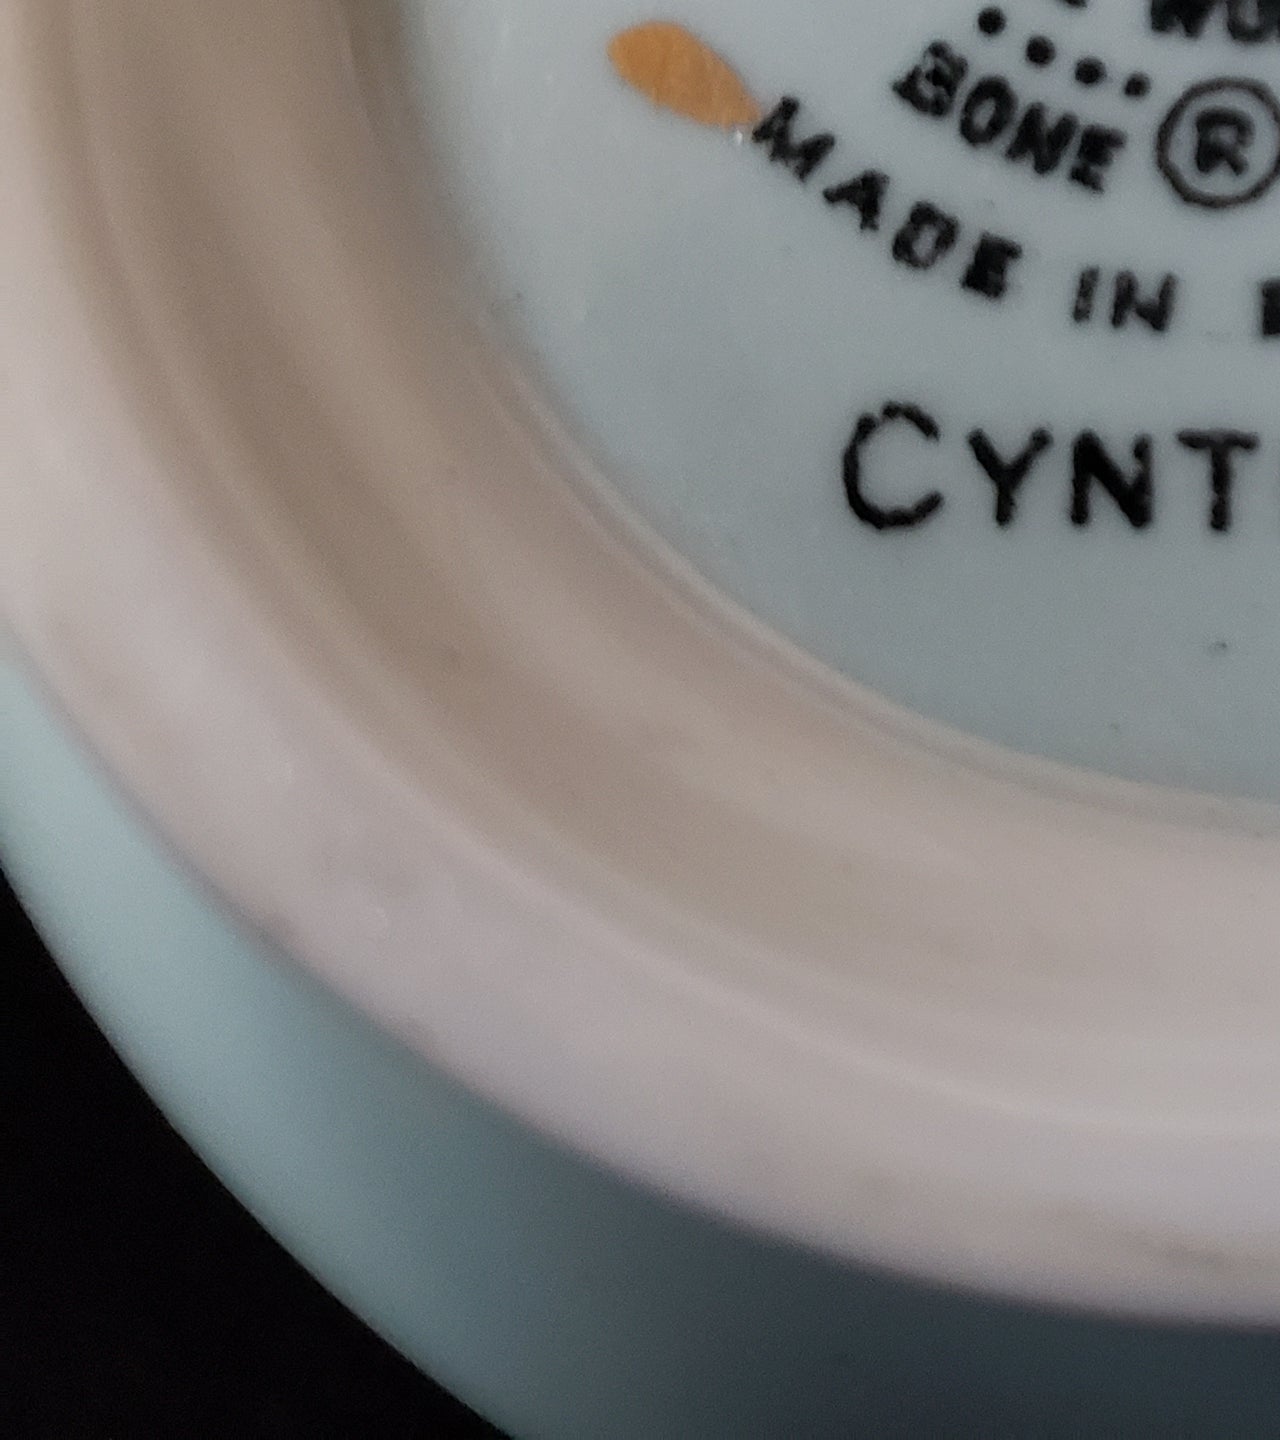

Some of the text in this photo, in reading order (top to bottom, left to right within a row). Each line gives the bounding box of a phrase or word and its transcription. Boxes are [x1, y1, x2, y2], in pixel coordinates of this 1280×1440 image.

[895, 42, 1129, 193] BONE
[752, 97, 1022, 298] MADE
[1072, 268, 1179, 332] IN
